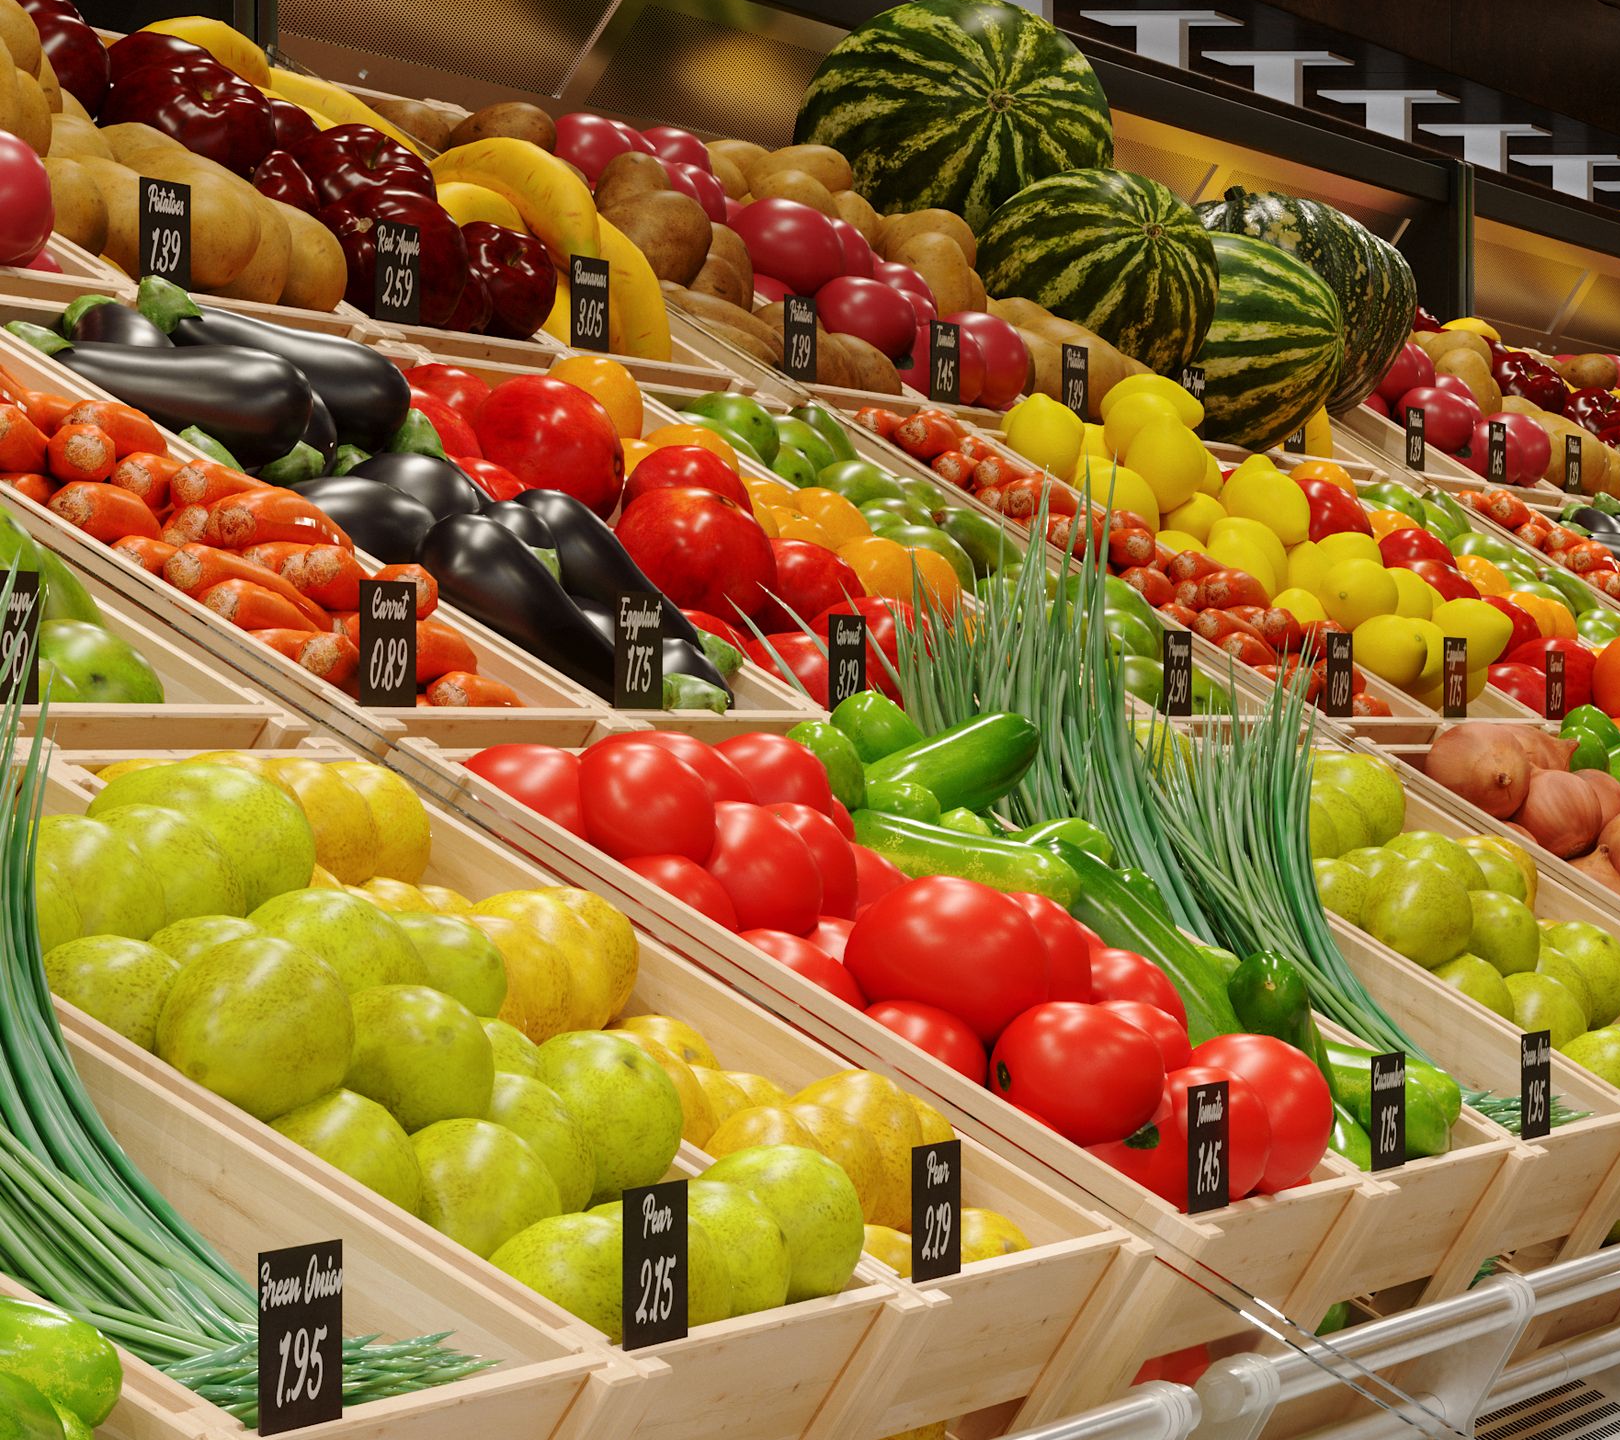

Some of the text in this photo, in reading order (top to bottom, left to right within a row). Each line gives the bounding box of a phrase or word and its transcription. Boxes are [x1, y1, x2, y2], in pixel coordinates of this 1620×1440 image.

[148, 184, 184, 216] Potatoes
[150, 227, 181, 273] 1.39
[377, 225, 420, 266] Red Apple
[382, 266, 413, 308] 2.59
[574, 260, 607, 288] Bananas
[577, 298, 604, 338] 3.05
[790, 299, 813, 324] Potatoes
[791, 334, 811, 369] 1.39
[936, 325, 956, 348] Tomato
[936, 357, 955, 392] 1.45
[1067, 348, 1085, 370] Potatoes
[1068, 379, 1084, 410] 1.39
[1410, 436, 1421, 462] 1.39
[372, 587, 410, 620] Carrot
[620, 597, 662, 641] Eggplant
[370, 638, 407, 691] 0.89
[625, 644, 654, 692] 1.75
[837, 659, 859, 700] 3.19
[1168, 668, 1188, 703] 2.90
[1373, 1056, 1405, 1091] Cucumber
[1196, 1090, 1223, 1127] Tomato
[1527, 1079, 1546, 1125] 1.95
[1380, 1105, 1398, 1154] 1.15
[927, 1150, 950, 1189] Pear
[1197, 1140, 1222, 1195] 1.45
[642, 1193, 673, 1239] Pear
[922, 1202, 951, 1260] 2.19
[635, 1254, 676, 1324] 2.15
[276, 1325, 328, 1407] 1.95
